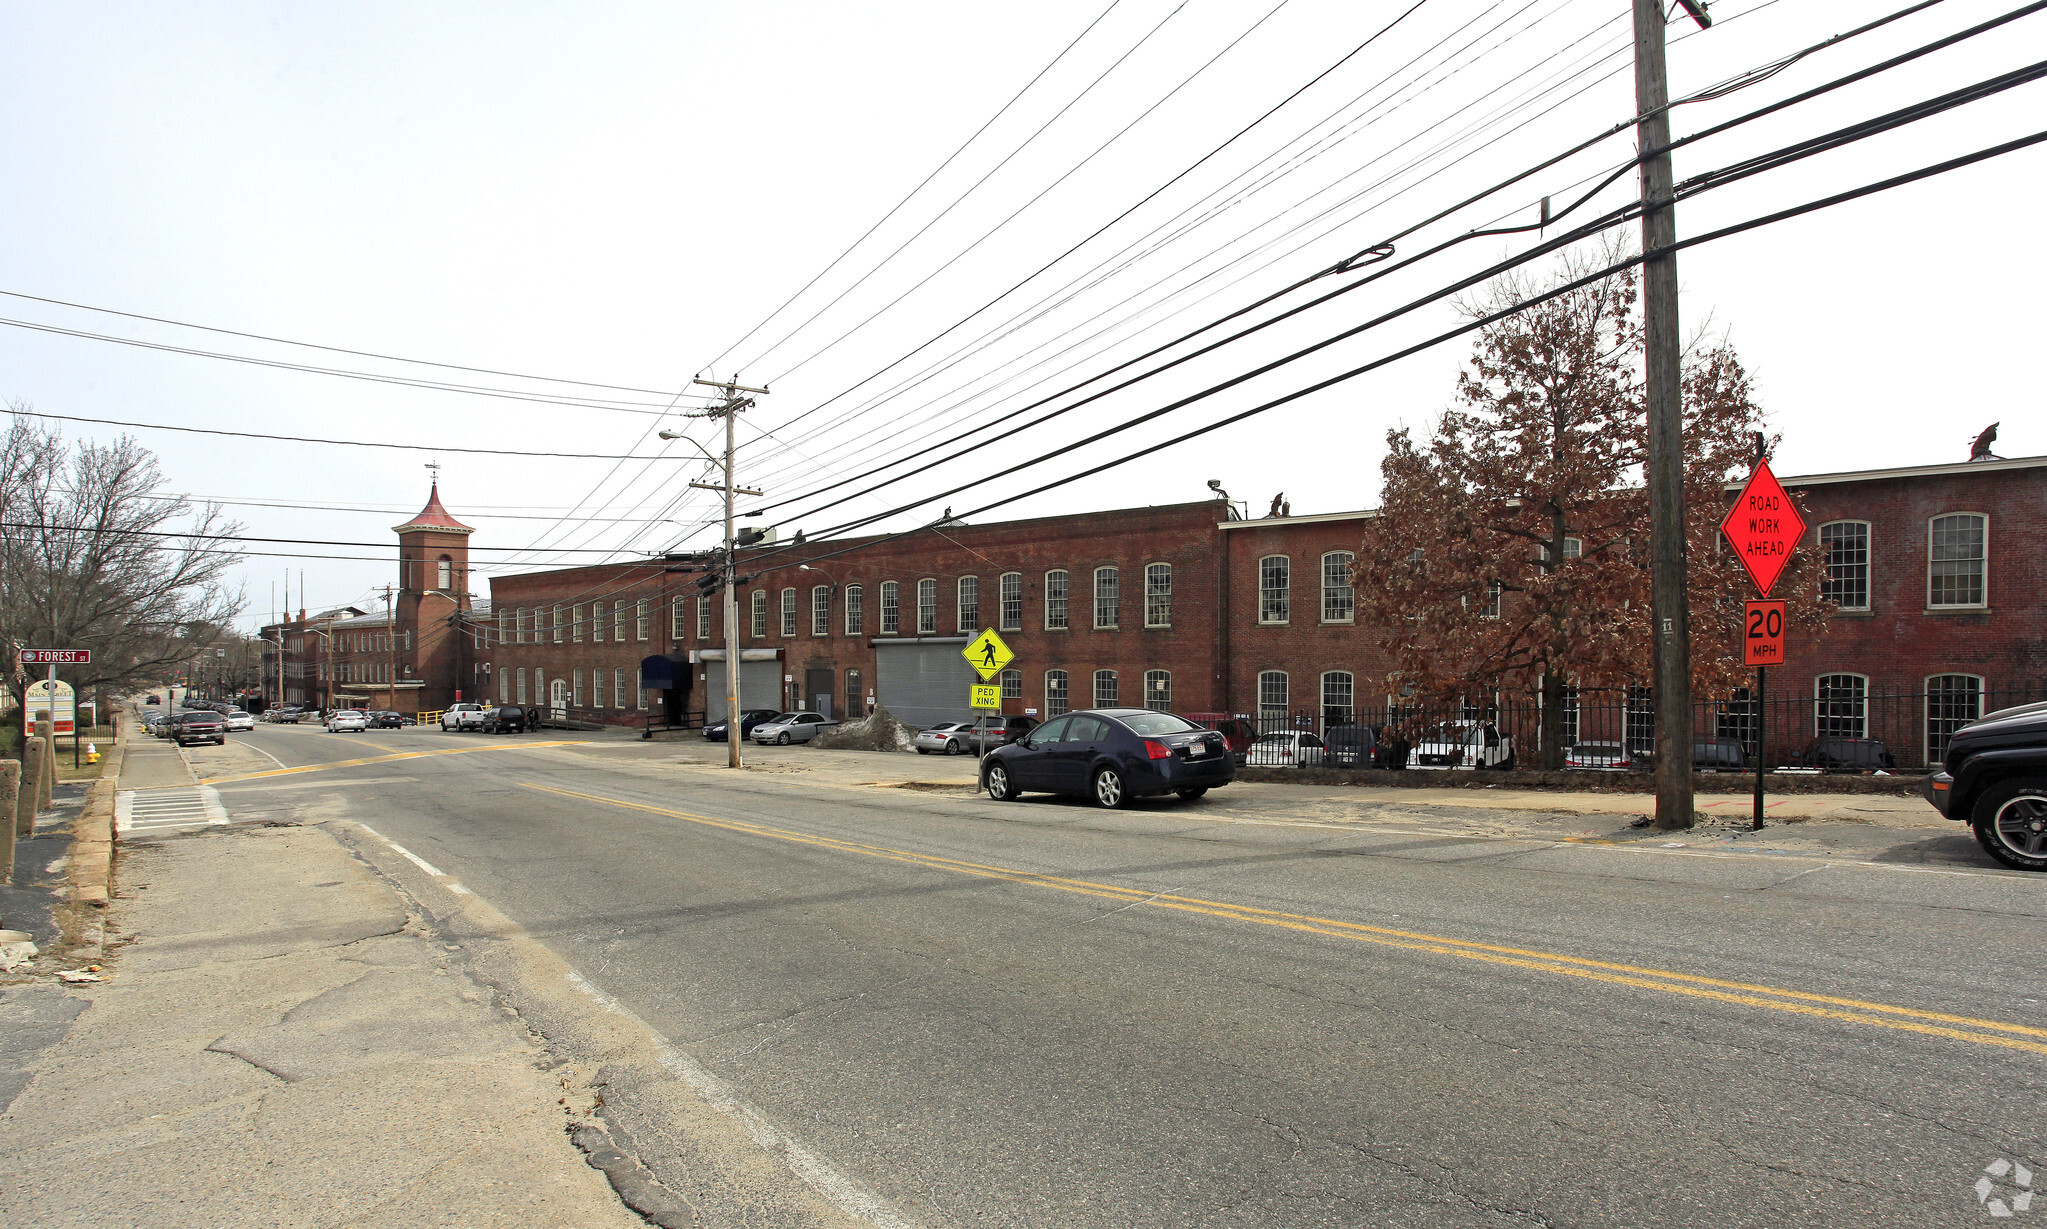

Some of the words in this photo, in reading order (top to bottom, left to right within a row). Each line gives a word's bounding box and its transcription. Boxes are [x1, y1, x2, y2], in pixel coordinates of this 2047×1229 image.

[1749, 496, 1780, 511] ROAD
[1749, 518, 1780, 533] WORK
[1746, 541, 1785, 556] AHEAD
[1748, 609, 1782, 638] 20
[38, 651, 77, 662] FOREST
[1753, 644, 1777, 657] MPH
[977, 687, 995, 696] PED
[975, 697, 995, 706] XING
